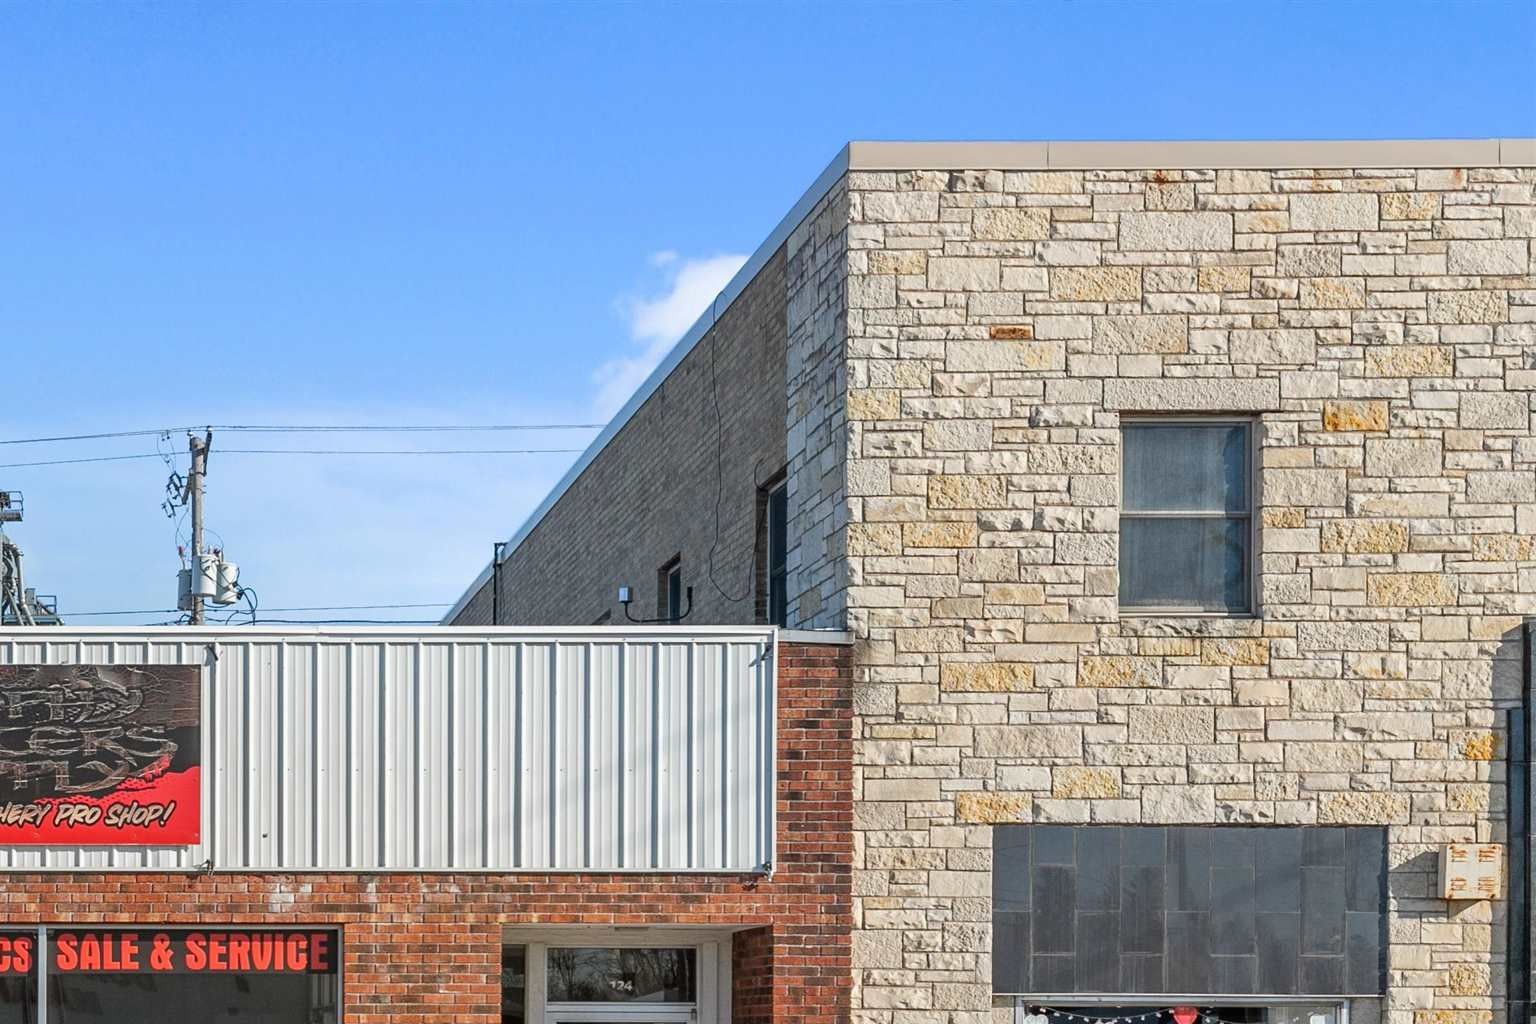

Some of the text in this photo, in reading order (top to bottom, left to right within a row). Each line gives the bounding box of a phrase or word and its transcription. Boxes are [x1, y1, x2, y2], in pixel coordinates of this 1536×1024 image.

[54, 802, 100, 826] PRO
[104, 802, 176, 827] SHOP!
[56, 934, 328, 970] SALE & SERVICE
[609, 980, 633, 992] 124
